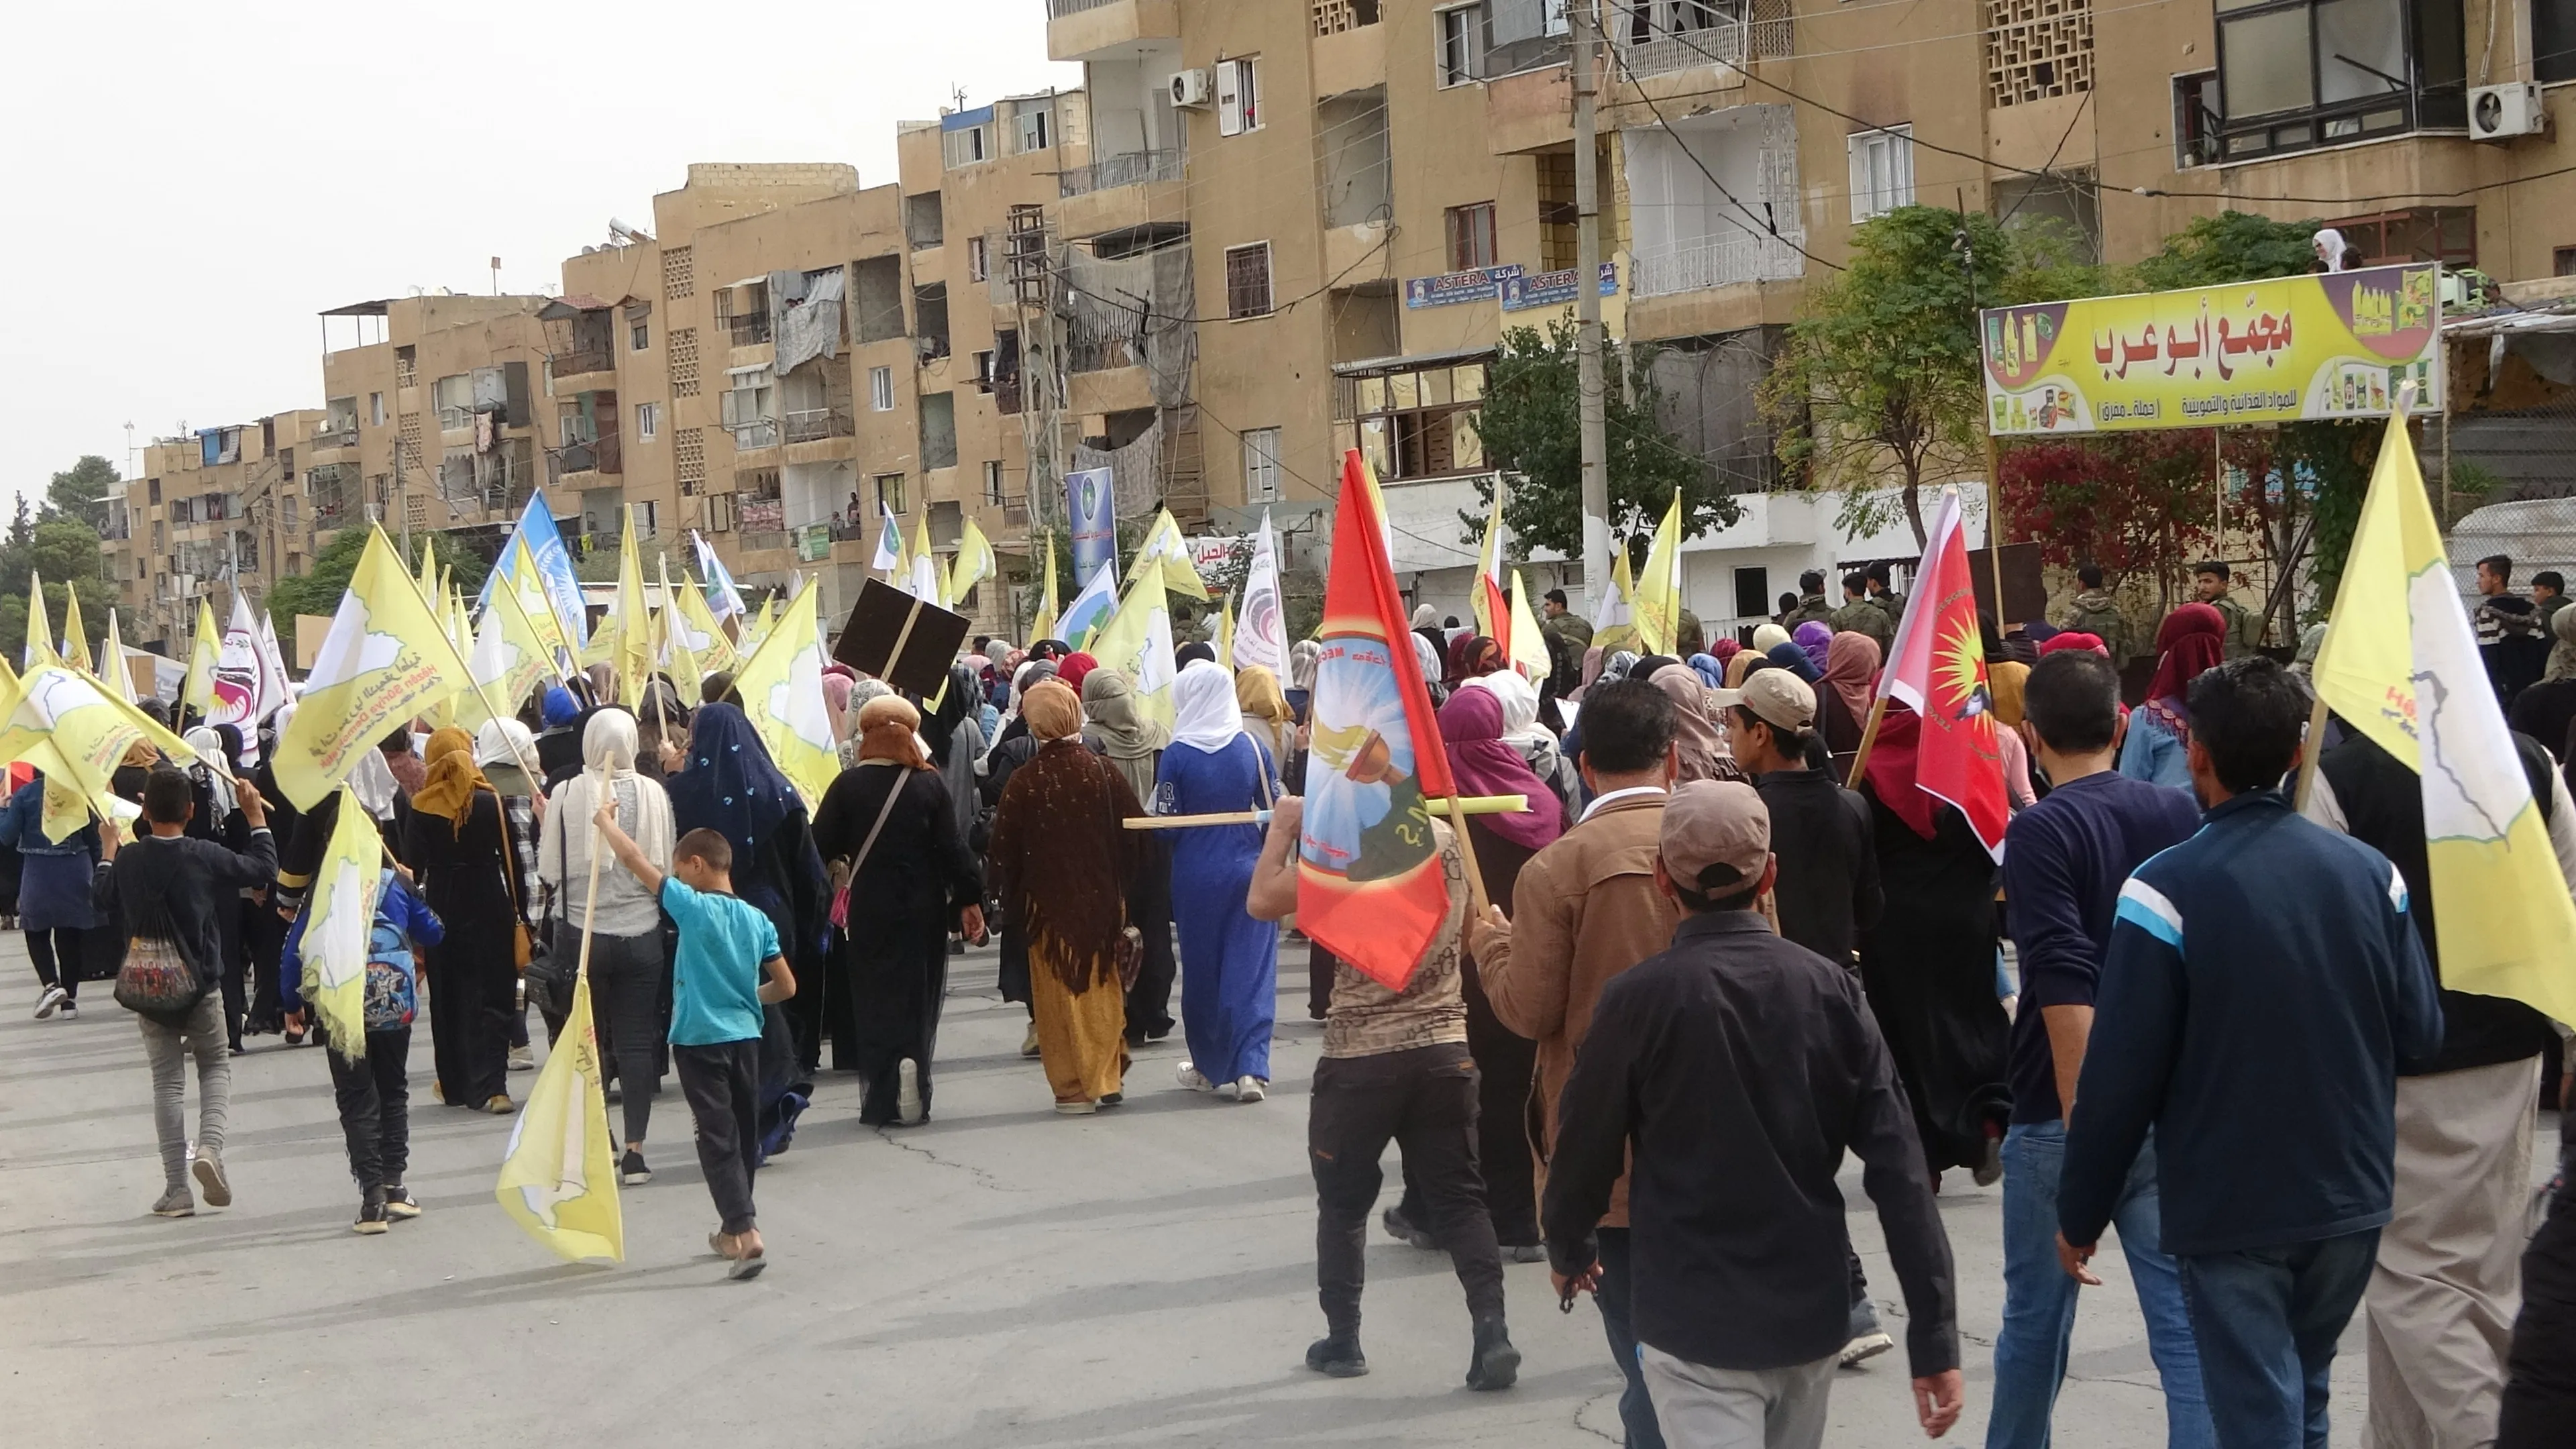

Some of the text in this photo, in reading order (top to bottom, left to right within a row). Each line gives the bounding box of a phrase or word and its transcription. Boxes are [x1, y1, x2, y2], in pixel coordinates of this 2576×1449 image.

[1434, 272, 1490, 292] ASTERA
[1495, 266, 1519, 280] شركة
[2163, 297, 2209, 380] أبو
[2094, 323, 2159, 382] عرب
[2182, 395, 2229, 419] والتموينية
[2231, 392, 2266, 415] الغذائية
[2267, 389, 2297, 412] للمواد
